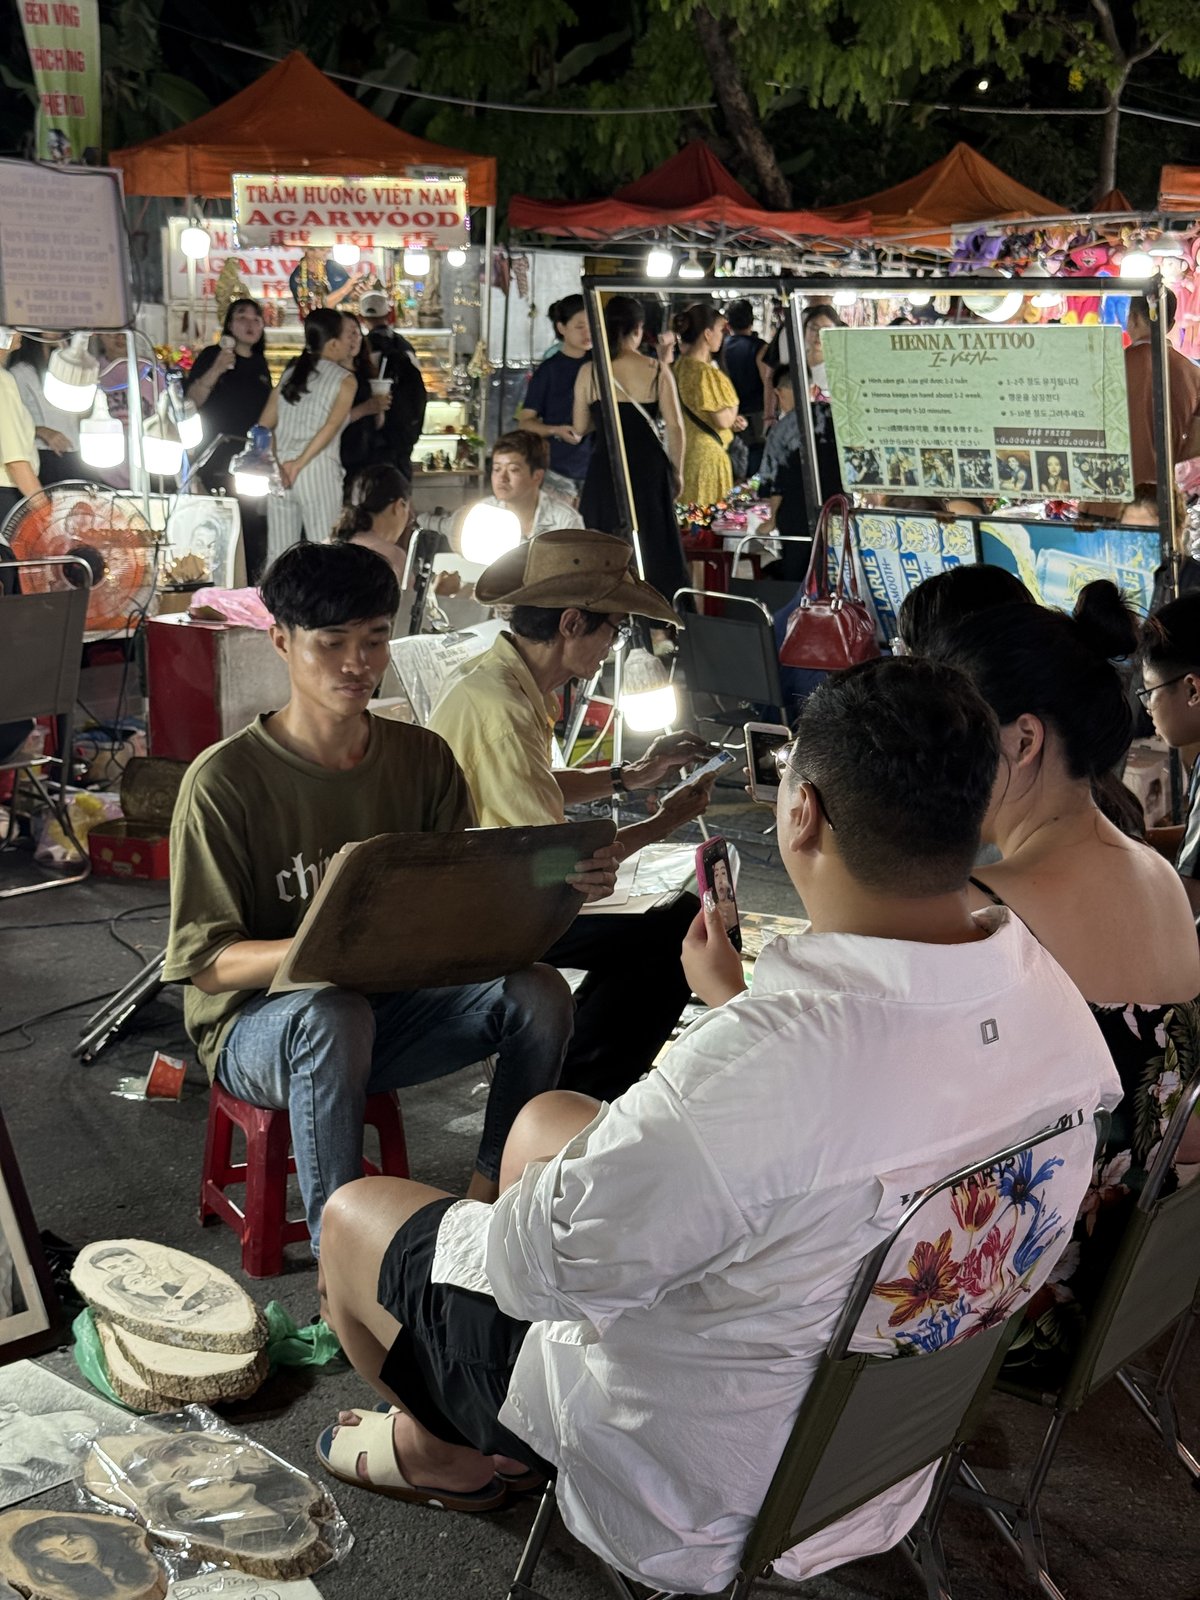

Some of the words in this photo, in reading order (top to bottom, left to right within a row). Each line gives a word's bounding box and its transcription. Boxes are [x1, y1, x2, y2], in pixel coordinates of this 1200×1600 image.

[245, 178, 296, 204] TRẦM
[418, 188, 457, 206] NAM
[245, 210, 460, 227] AGARWOOD
[890, 334, 954, 351] HENNA
[959, 332, 1035, 350] TATTOO
[863, 555, 892, 611] LARUE
[882, 557, 902, 604] SMOOTH
